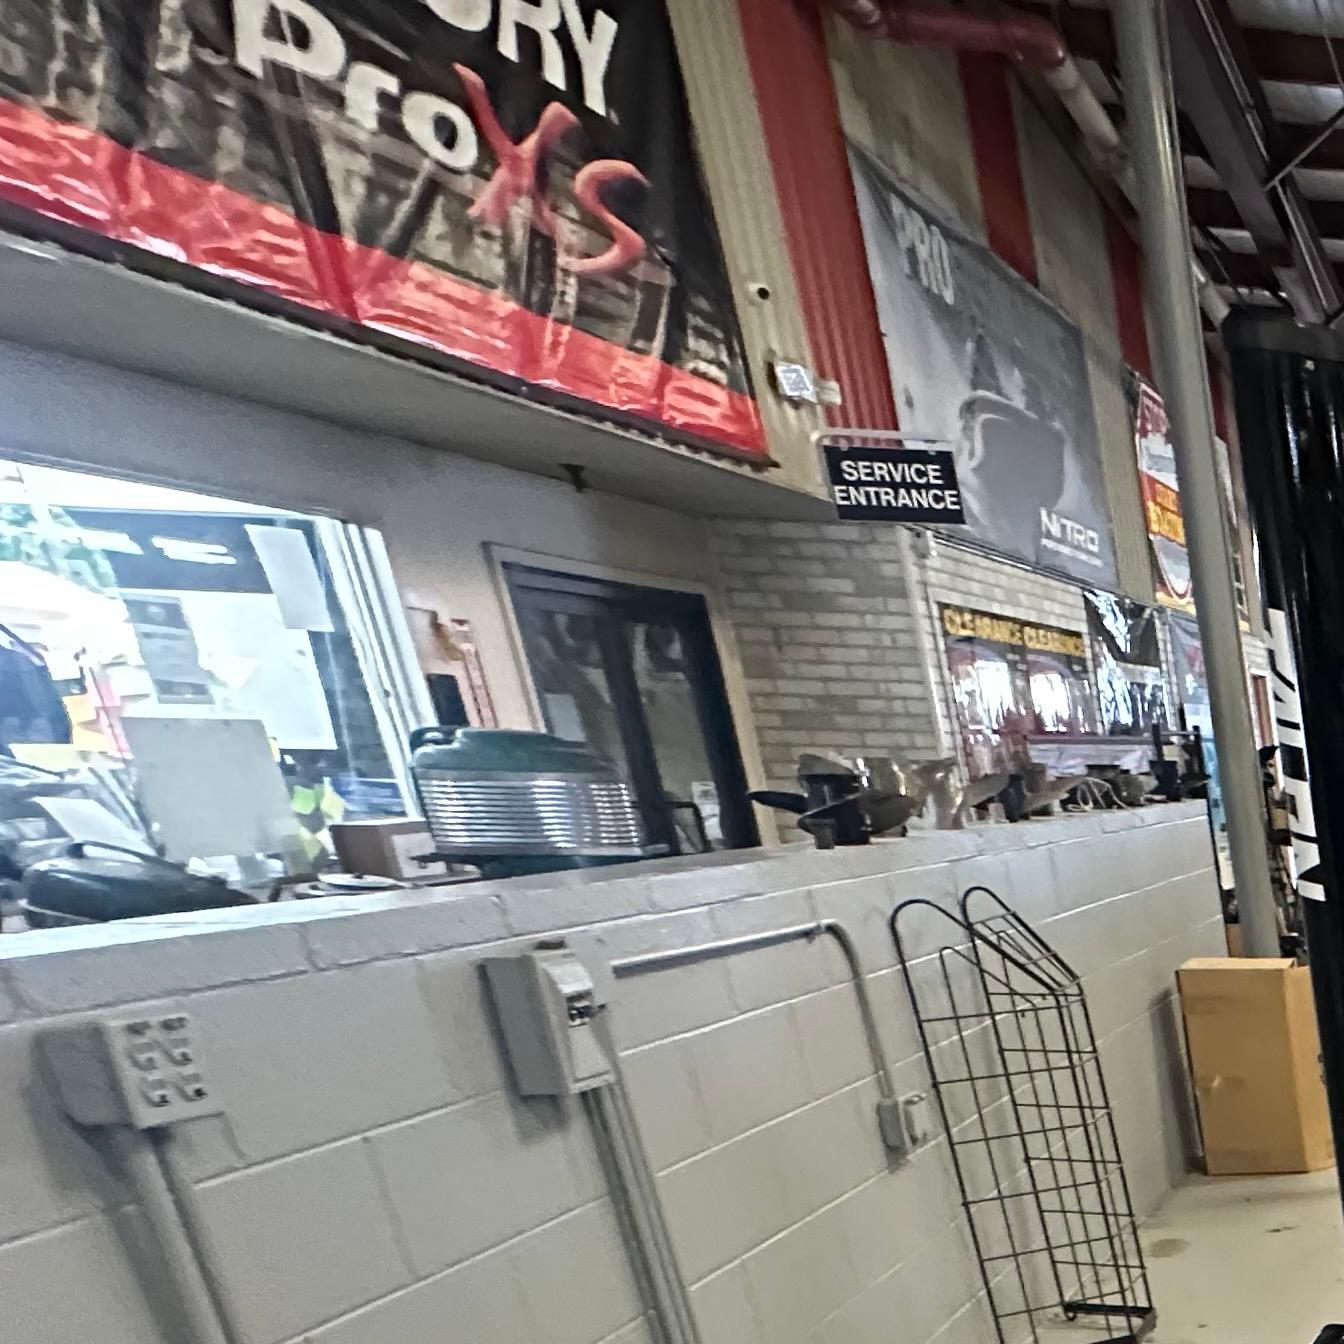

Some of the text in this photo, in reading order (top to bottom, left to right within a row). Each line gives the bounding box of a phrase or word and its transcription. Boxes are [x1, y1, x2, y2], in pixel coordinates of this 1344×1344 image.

[840, 460, 944, 485] SERVICE
[833, 486, 961, 510] ENTRANCE
[1040, 506, 1099, 553] NITRO
